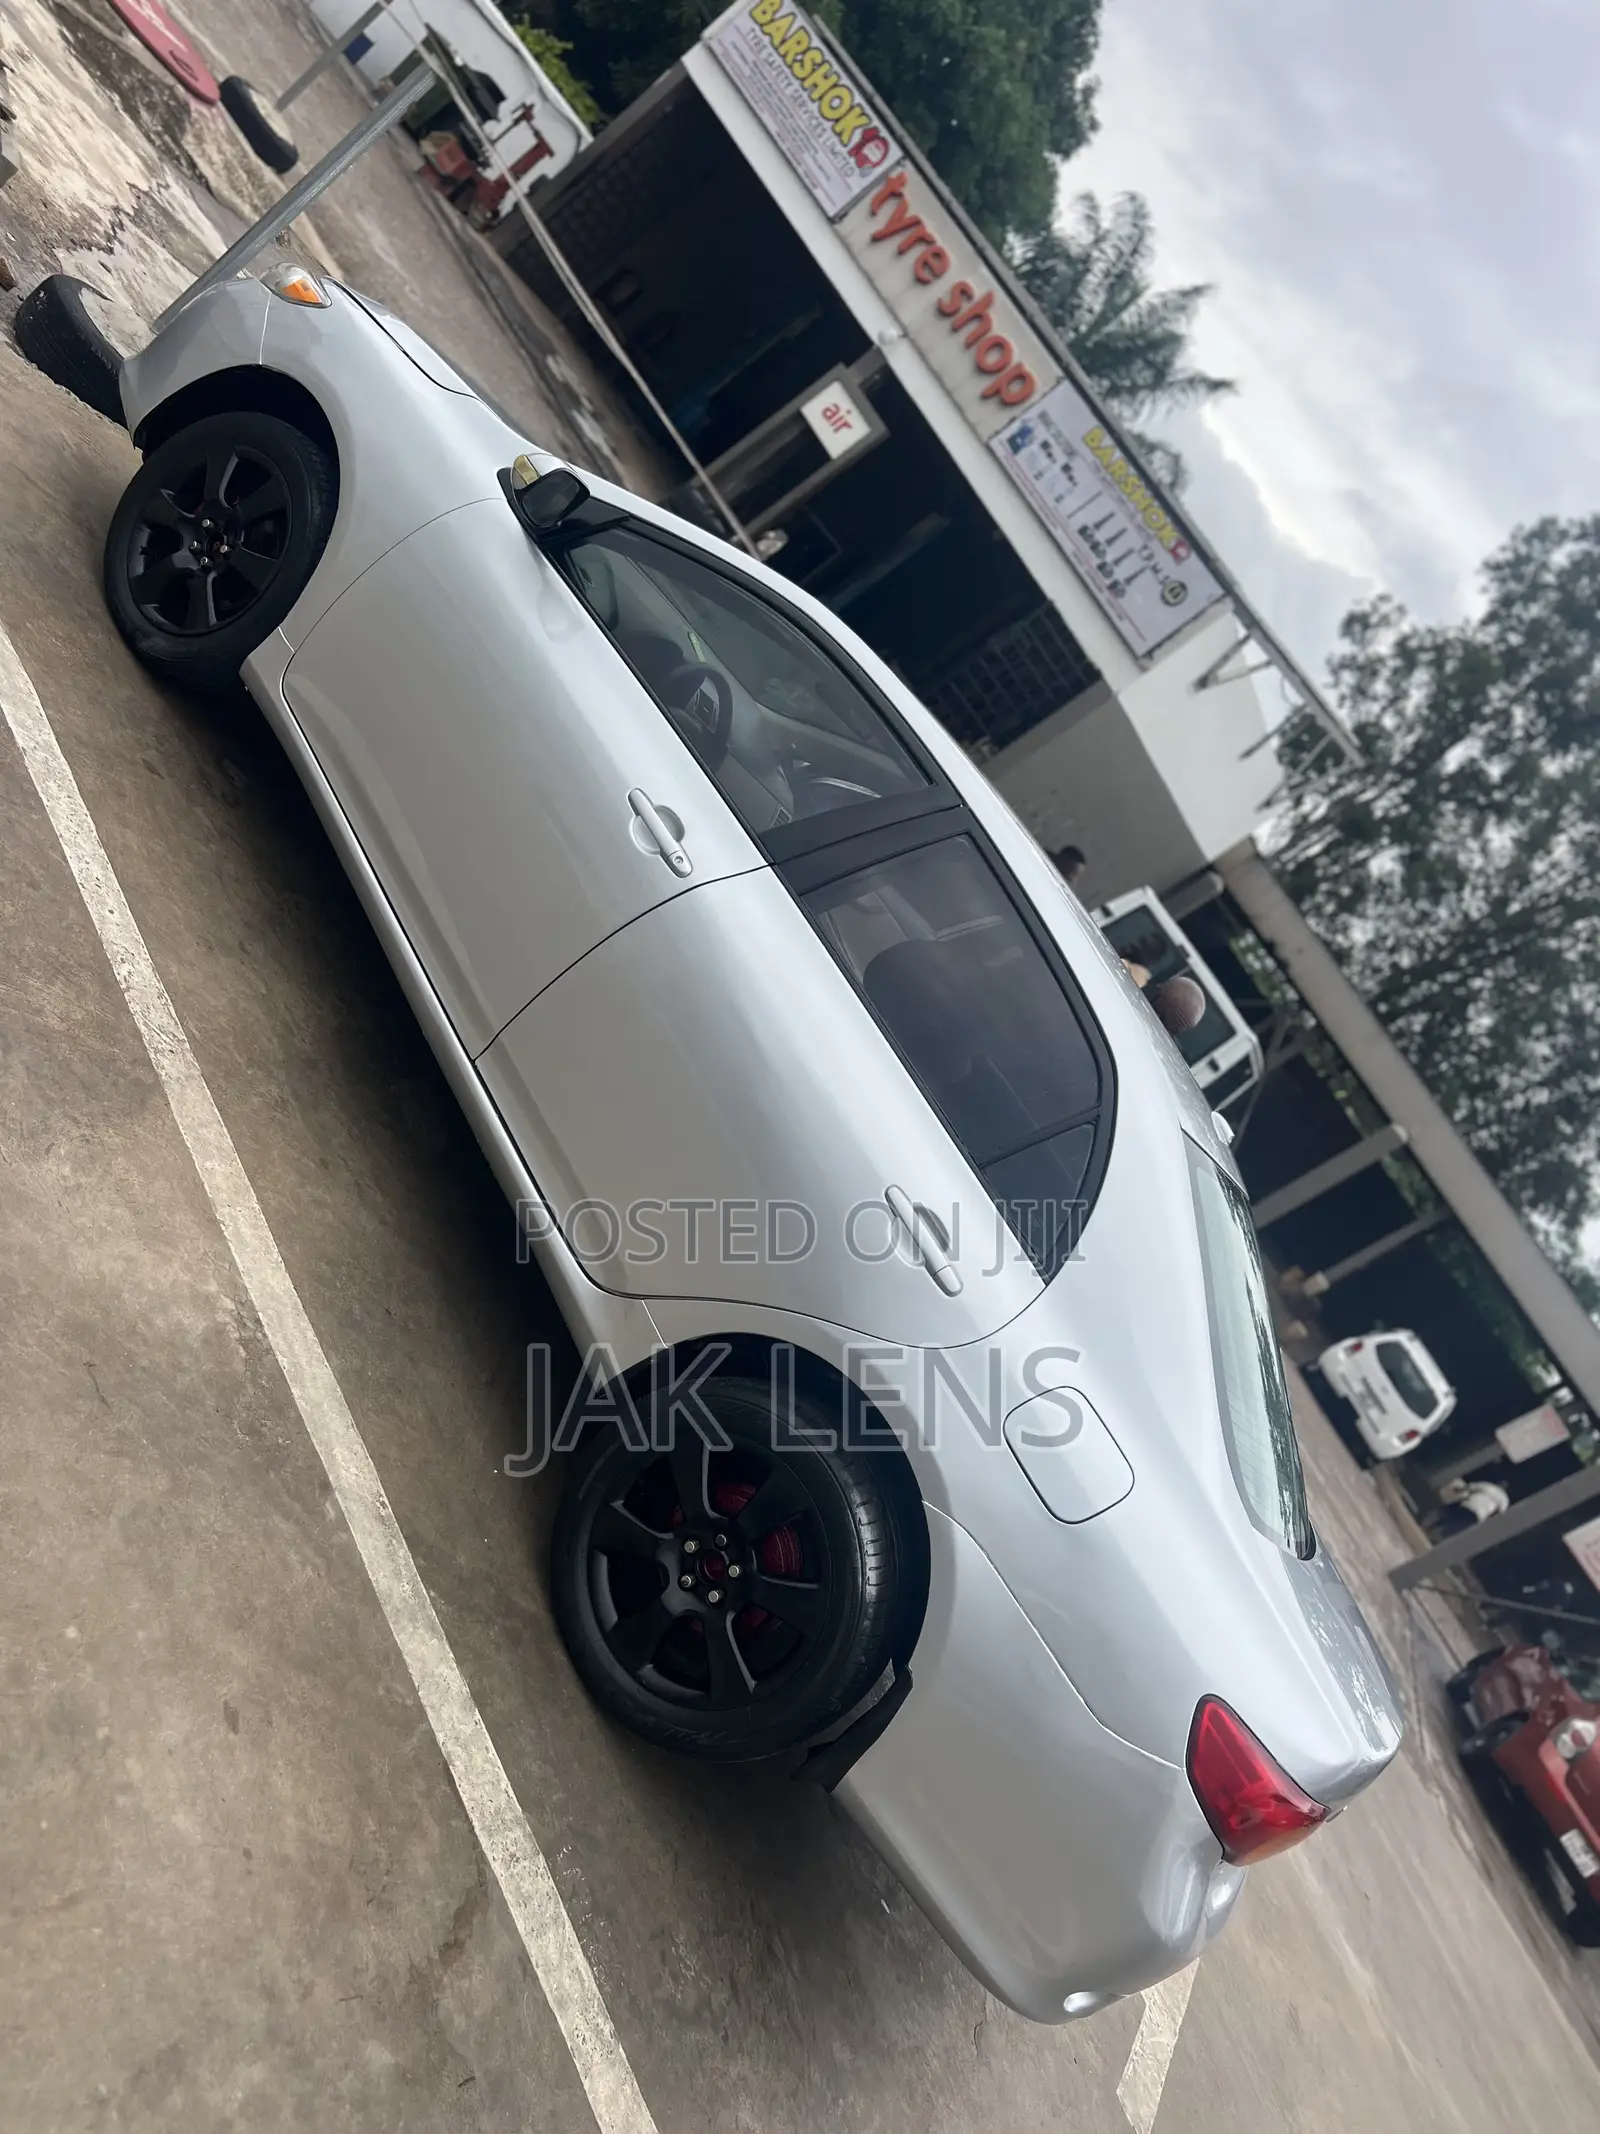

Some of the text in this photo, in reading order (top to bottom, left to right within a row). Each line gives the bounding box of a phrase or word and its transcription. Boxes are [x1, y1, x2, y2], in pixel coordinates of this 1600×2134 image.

[749, 0, 872, 147] BARSHOK
[870, 171, 950, 284] tyre
[938, 280, 1035, 405] shop
[822, 403, 852, 434] air
[1083, 426, 1178, 549] BARSHOK
